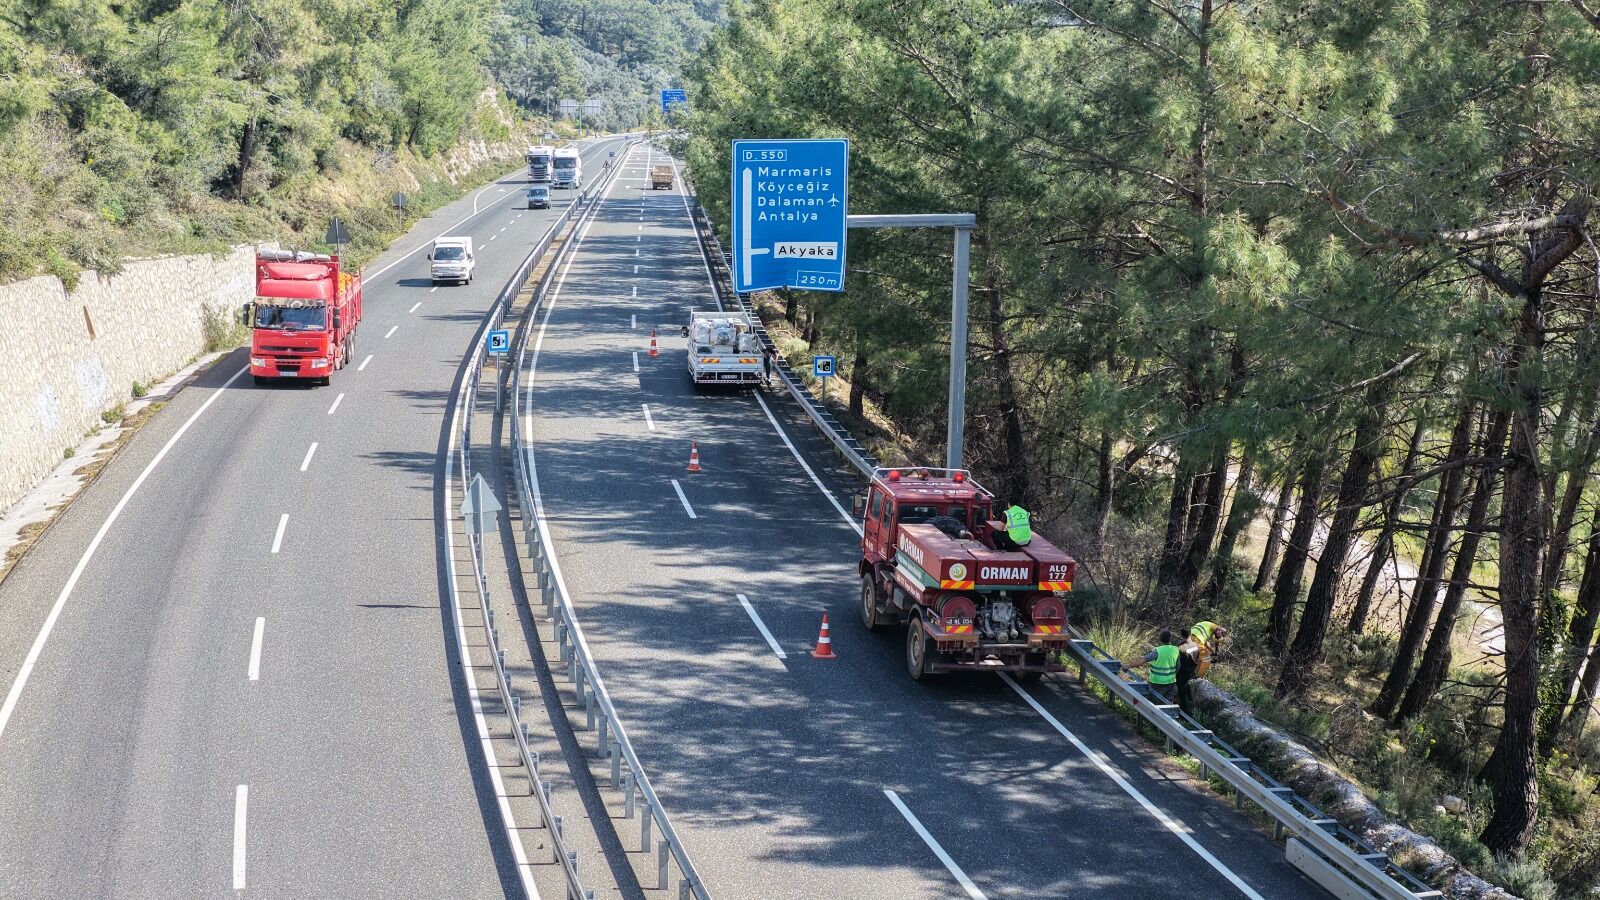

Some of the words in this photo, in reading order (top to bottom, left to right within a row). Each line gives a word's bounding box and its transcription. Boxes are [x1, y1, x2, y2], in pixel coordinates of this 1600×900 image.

[758, 166, 832, 177] Marmaris
[758, 181, 830, 193] Köyceğiz
[757, 196, 824, 207] Dalaman
[758, 210, 818, 223] Antalya
[778, 245, 834, 257] Akyaka
[904, 537, 924, 567] ORMAN
[980, 566, 1029, 580] ORMAN
[1049, 565, 1068, 573] ALO
[1048, 572, 1066, 580] 177
